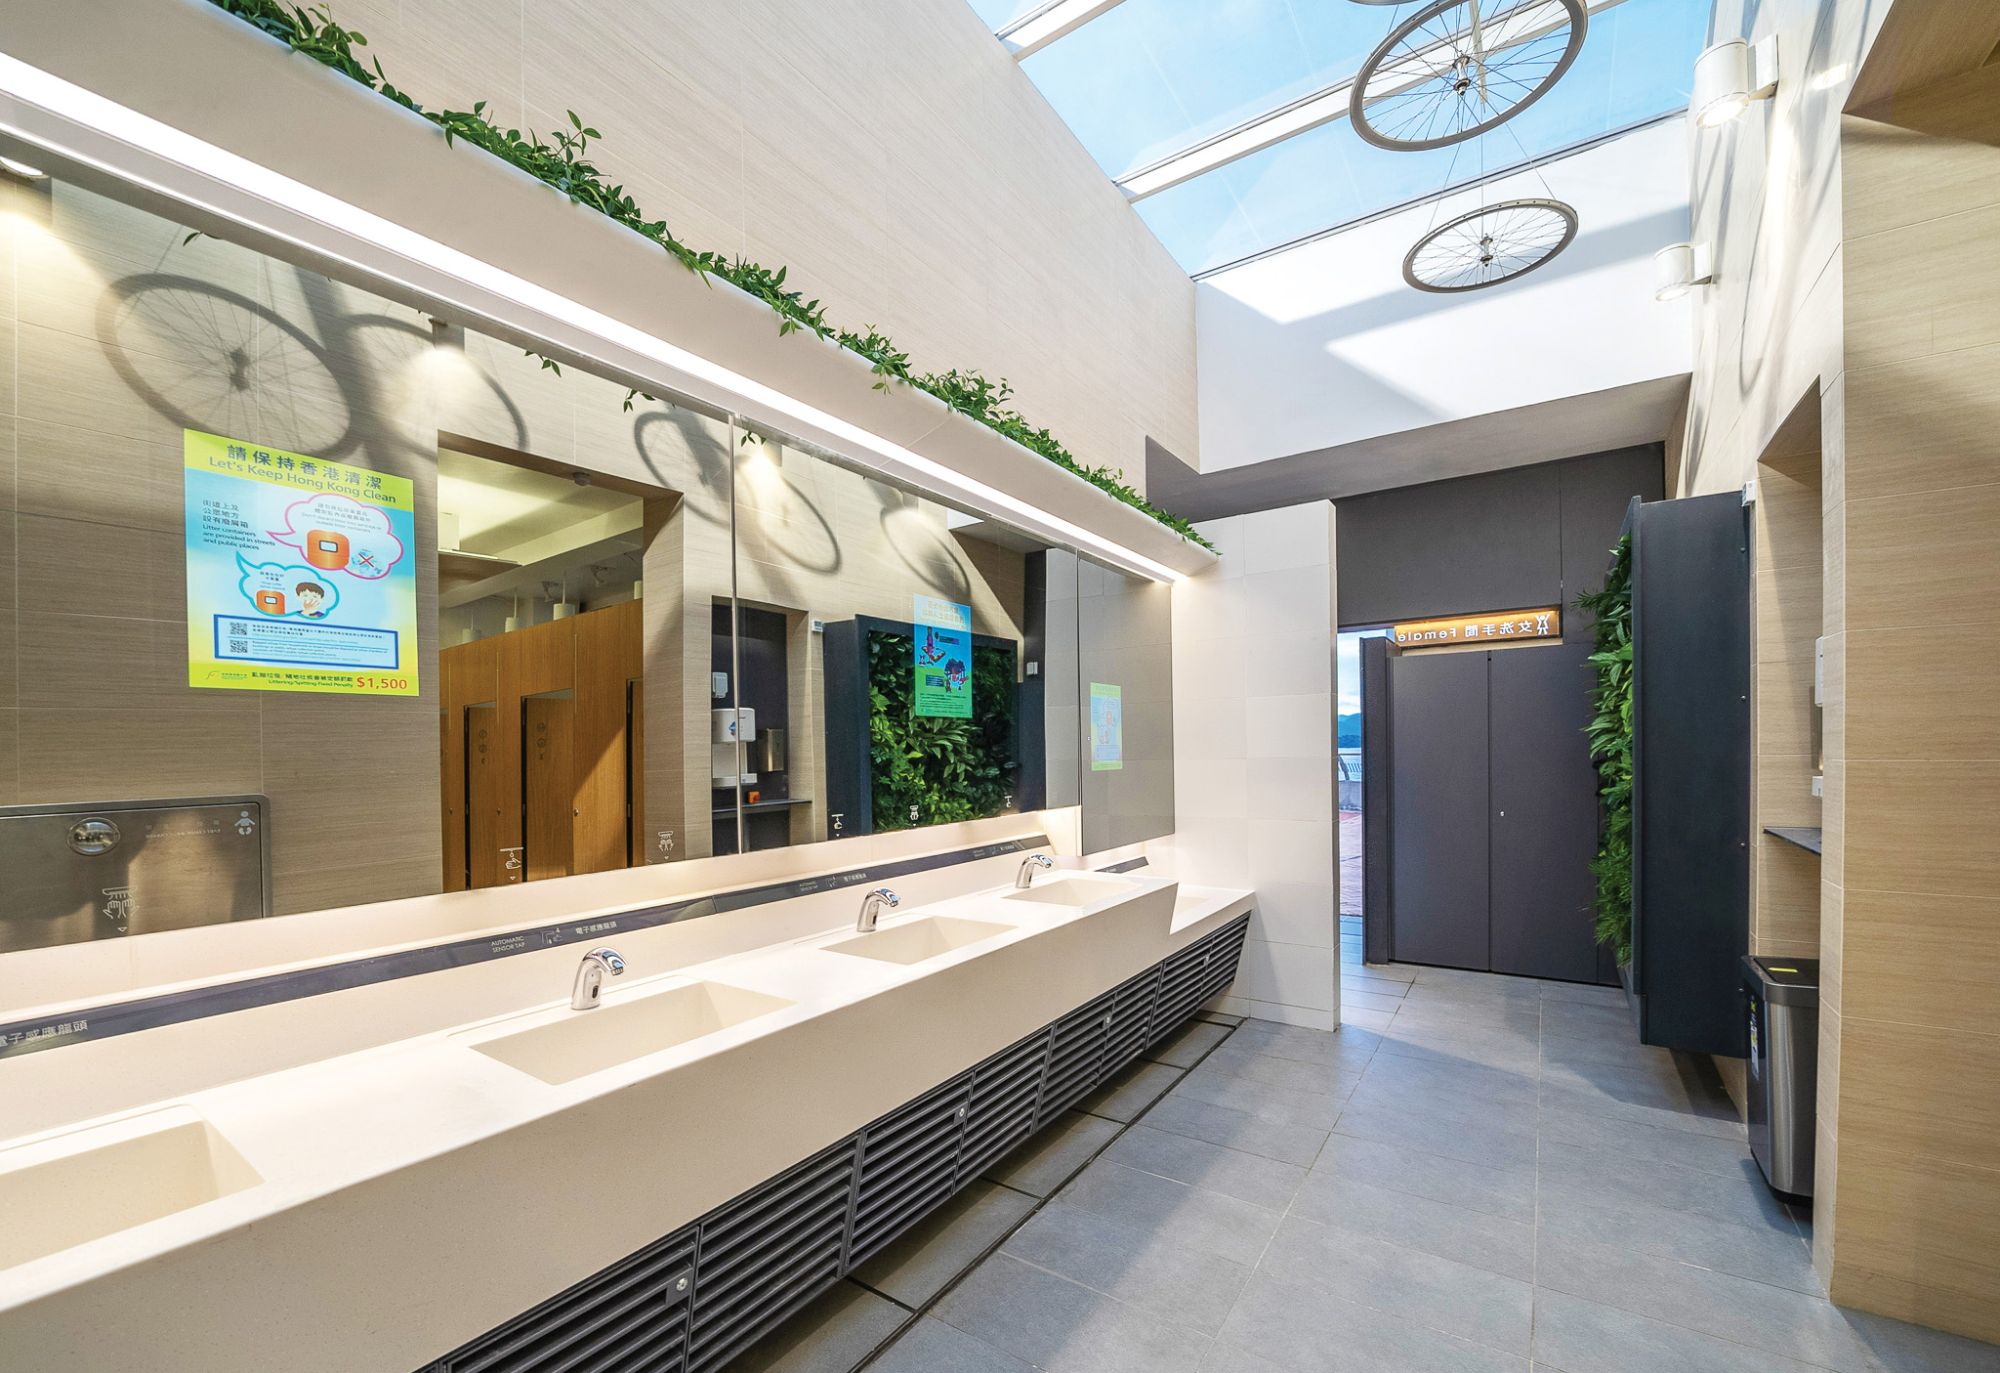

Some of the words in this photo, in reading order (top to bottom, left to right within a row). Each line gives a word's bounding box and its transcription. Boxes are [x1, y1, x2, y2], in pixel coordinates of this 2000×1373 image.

[209, 456, 243, 472] Let's
[248, 464, 283, 481] Keep
[287, 473, 323, 490] Hong
[327, 481, 360, 497] Kong
[363, 489, 397, 504] Clean
[227, 444, 382, 490] 請保持香港清潔
[356, 675, 408, 690] $1,500
[491, 935, 525, 947] AUTOMATIC
